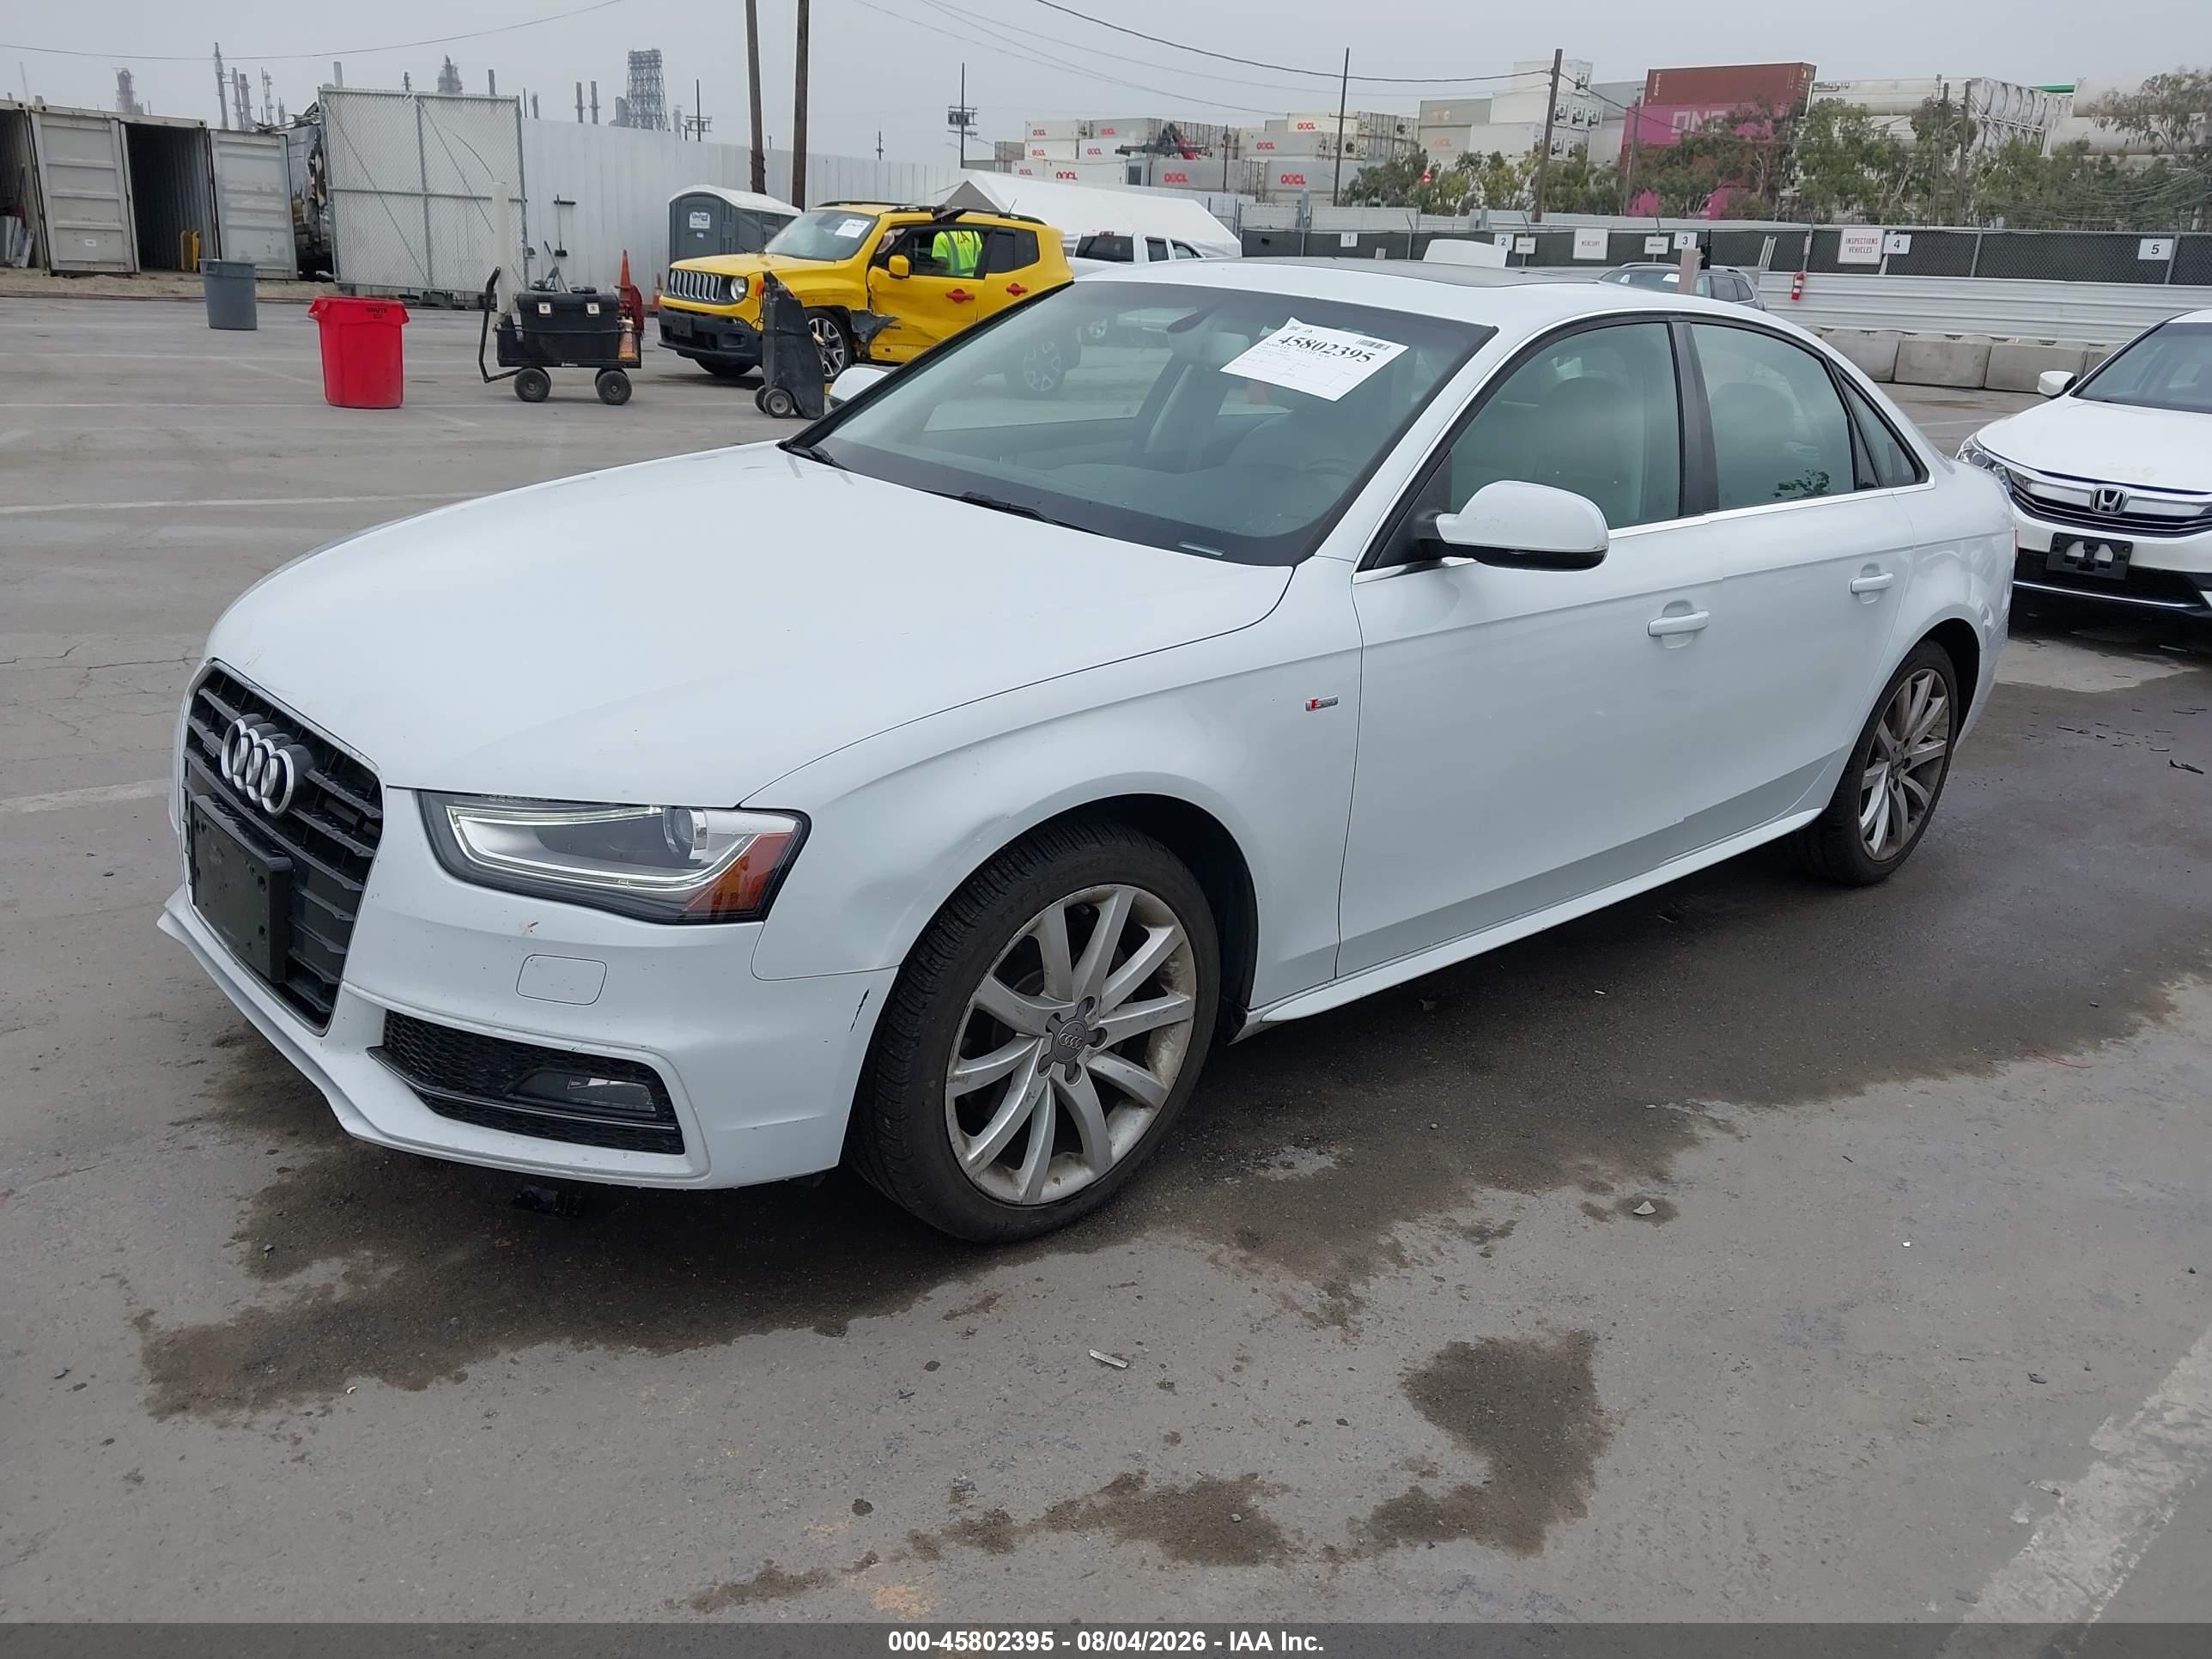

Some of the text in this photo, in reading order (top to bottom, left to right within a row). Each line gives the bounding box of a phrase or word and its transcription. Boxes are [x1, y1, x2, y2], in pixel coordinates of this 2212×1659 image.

[1164, 173, 1188, 183] OOCL
[1280, 174, 1306, 185] OOCL
[1501, 238, 1506, 246] 2
[1682, 235, 1688, 246] 3
[1893, 240, 1900, 249] 4
[2151, 244, 2160, 254] 5
[1278, 335, 1376, 363] 45802395
